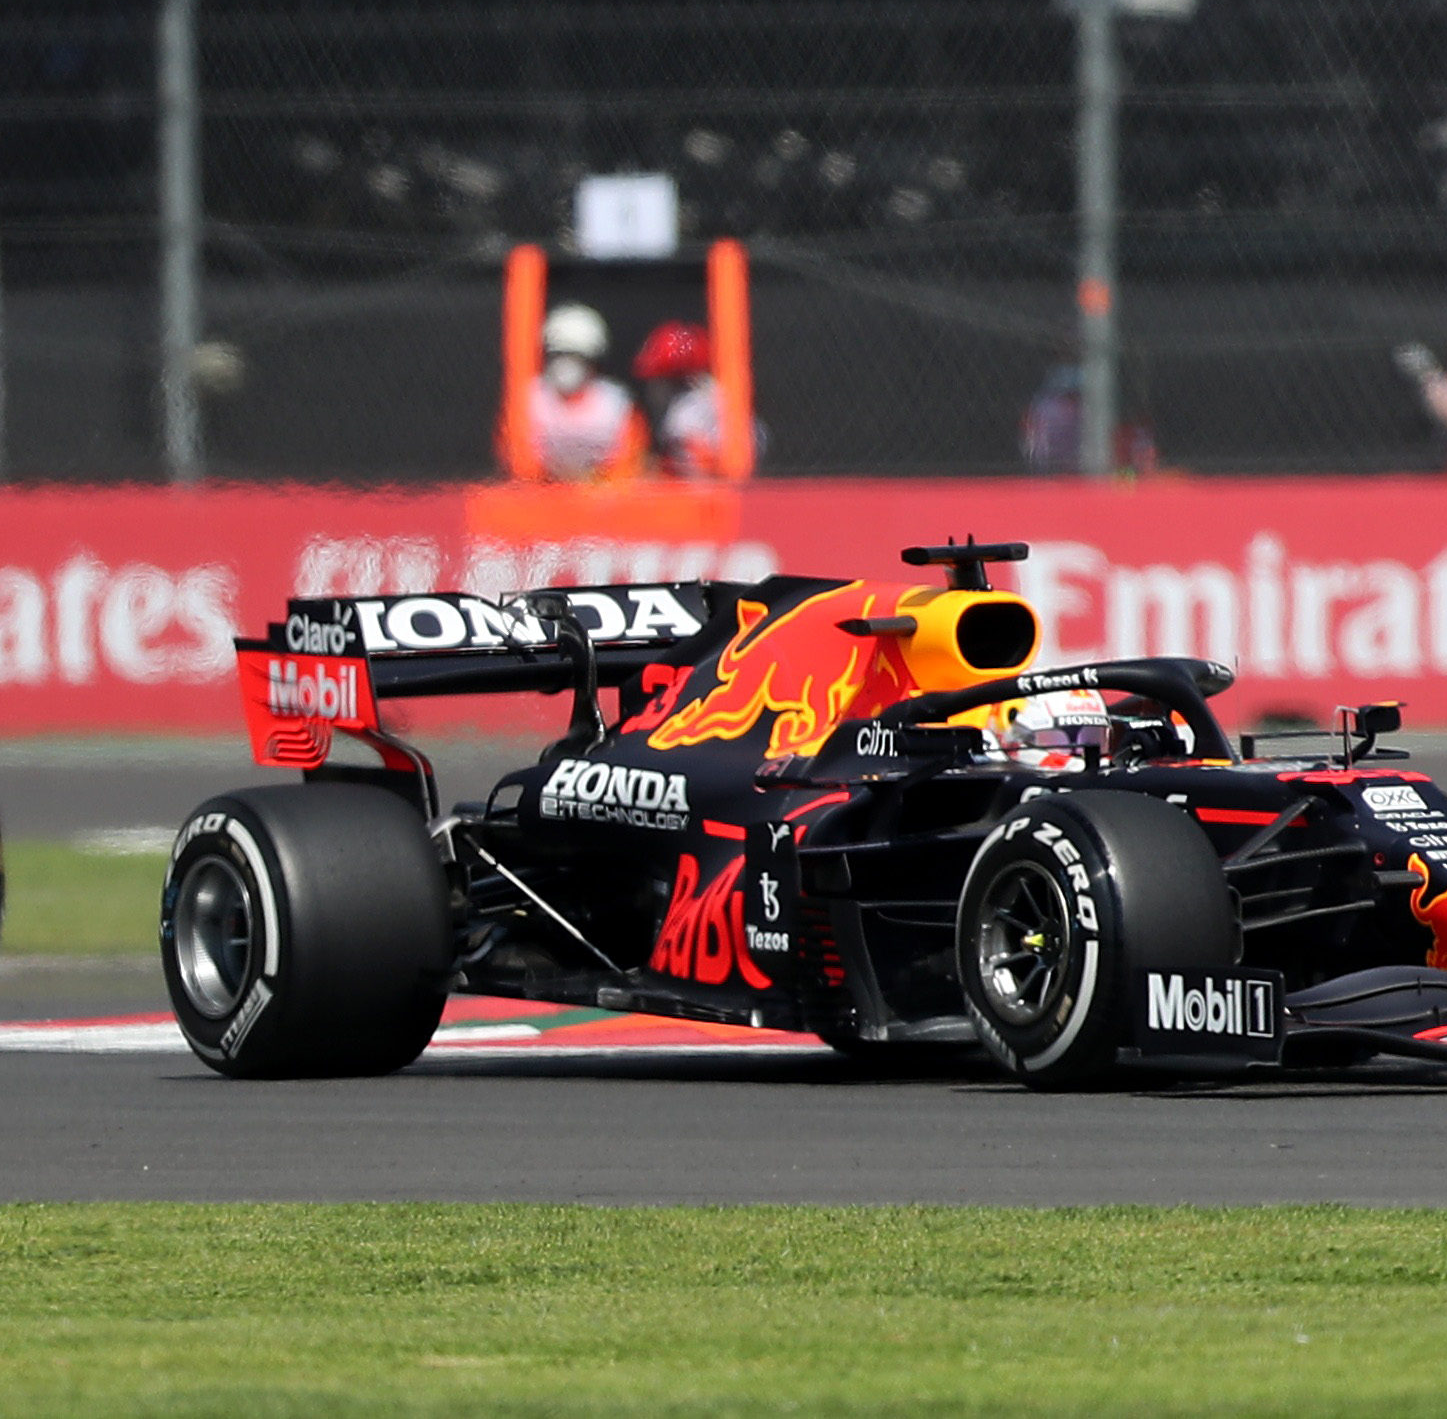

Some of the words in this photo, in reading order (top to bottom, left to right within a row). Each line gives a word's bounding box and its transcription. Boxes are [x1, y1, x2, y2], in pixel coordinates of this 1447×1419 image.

[286, 613, 346, 655] Claro
[269, 659, 357, 719] Mobil
[542, 758, 690, 811] HONDA
[1005, 817, 1031, 840] P
[1033, 822, 1099, 931] ZERO
[746, 924, 790, 952] Tezos
[1148, 973, 1243, 1035] Mobil
